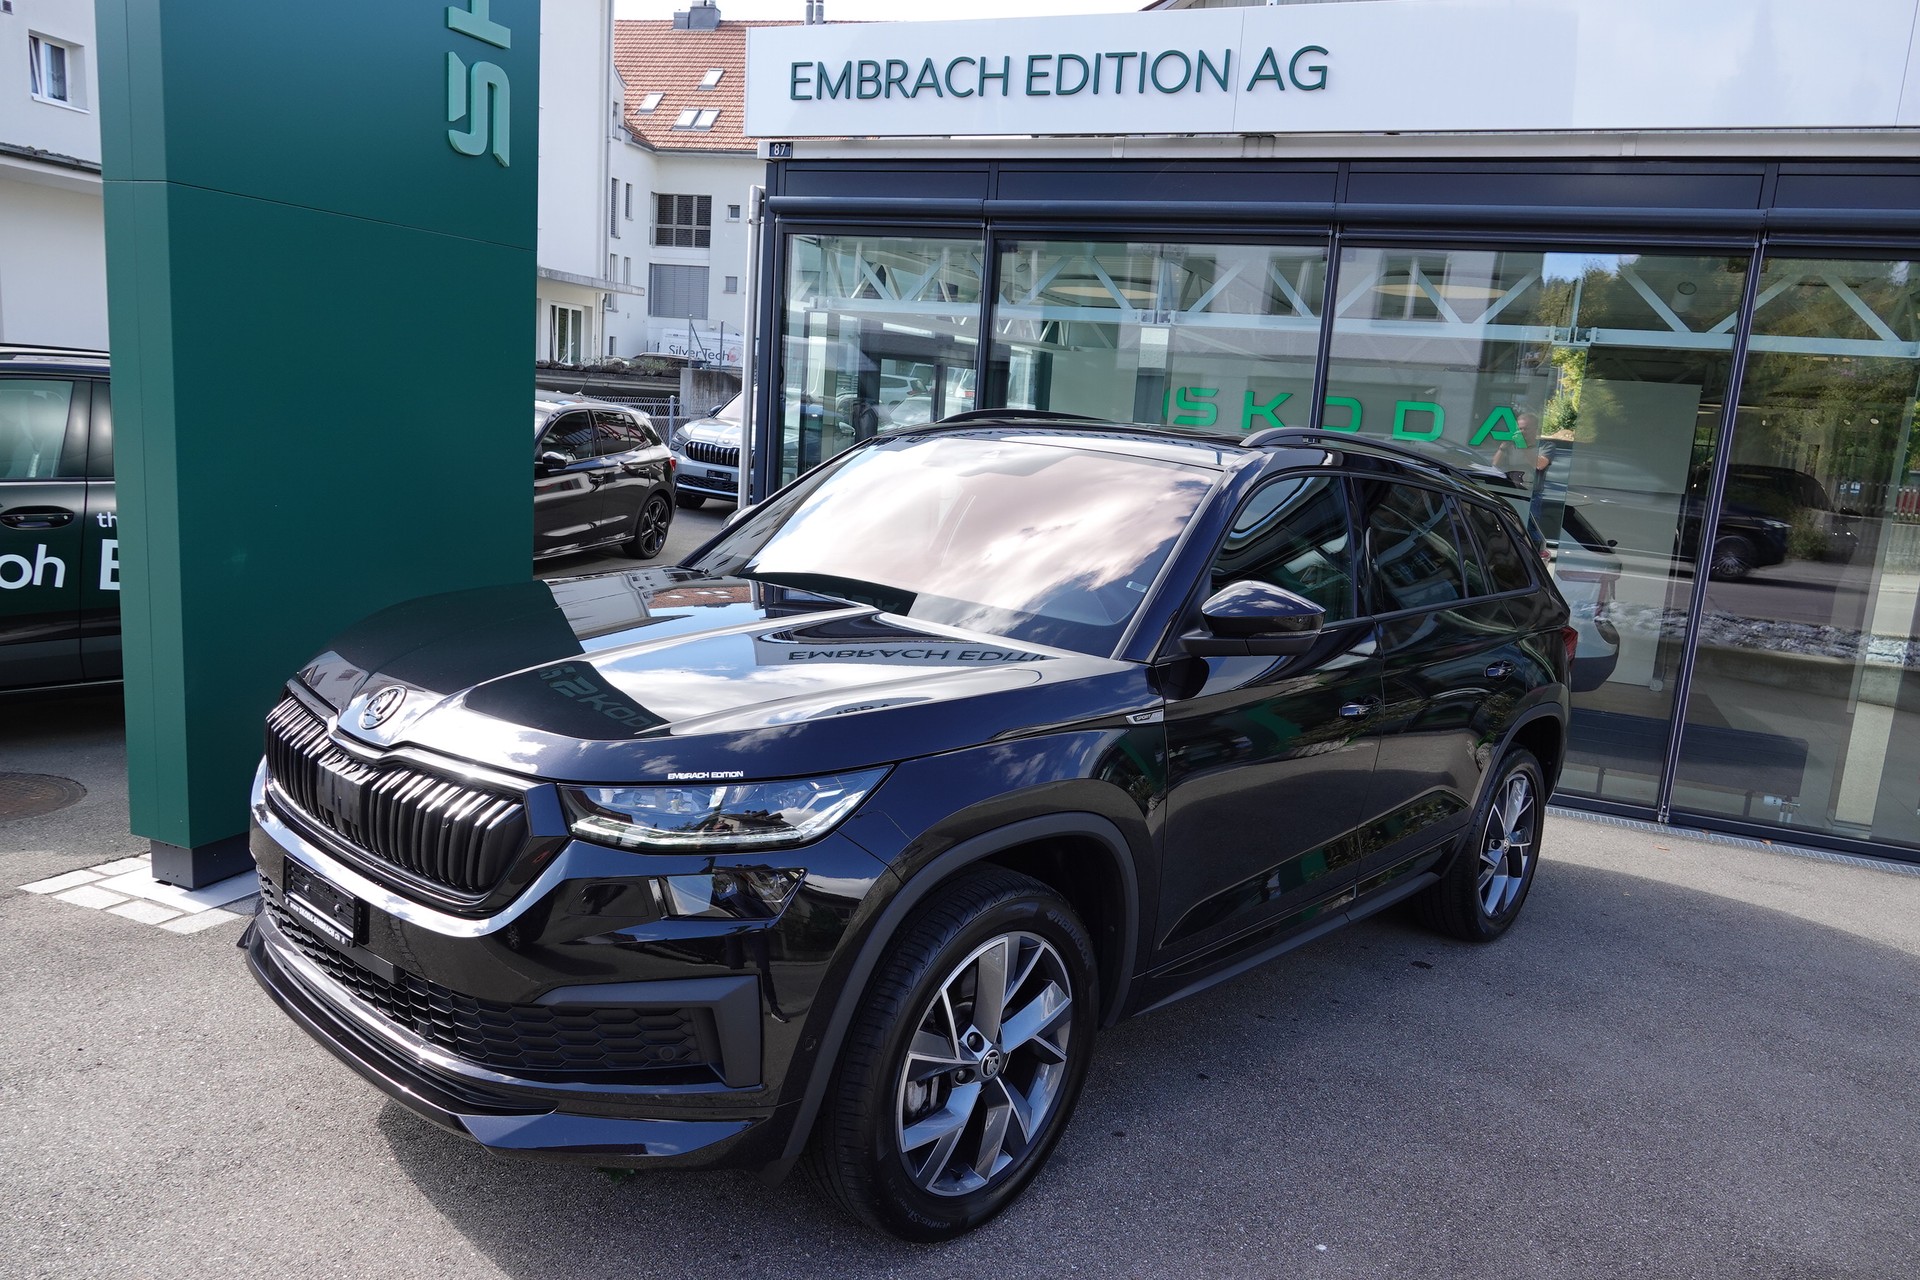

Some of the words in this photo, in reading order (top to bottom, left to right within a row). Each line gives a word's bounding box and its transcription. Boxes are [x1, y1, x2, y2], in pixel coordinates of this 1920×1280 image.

[790, 55, 1010, 101] EMBRACH
[1026, 48, 1231, 96] EDITION
[1246, 45, 1329, 92] AG
[773, 143, 787, 156] 87
[667, 772, 709, 780] EMBRACH
[711, 770, 744, 779] EDITION
